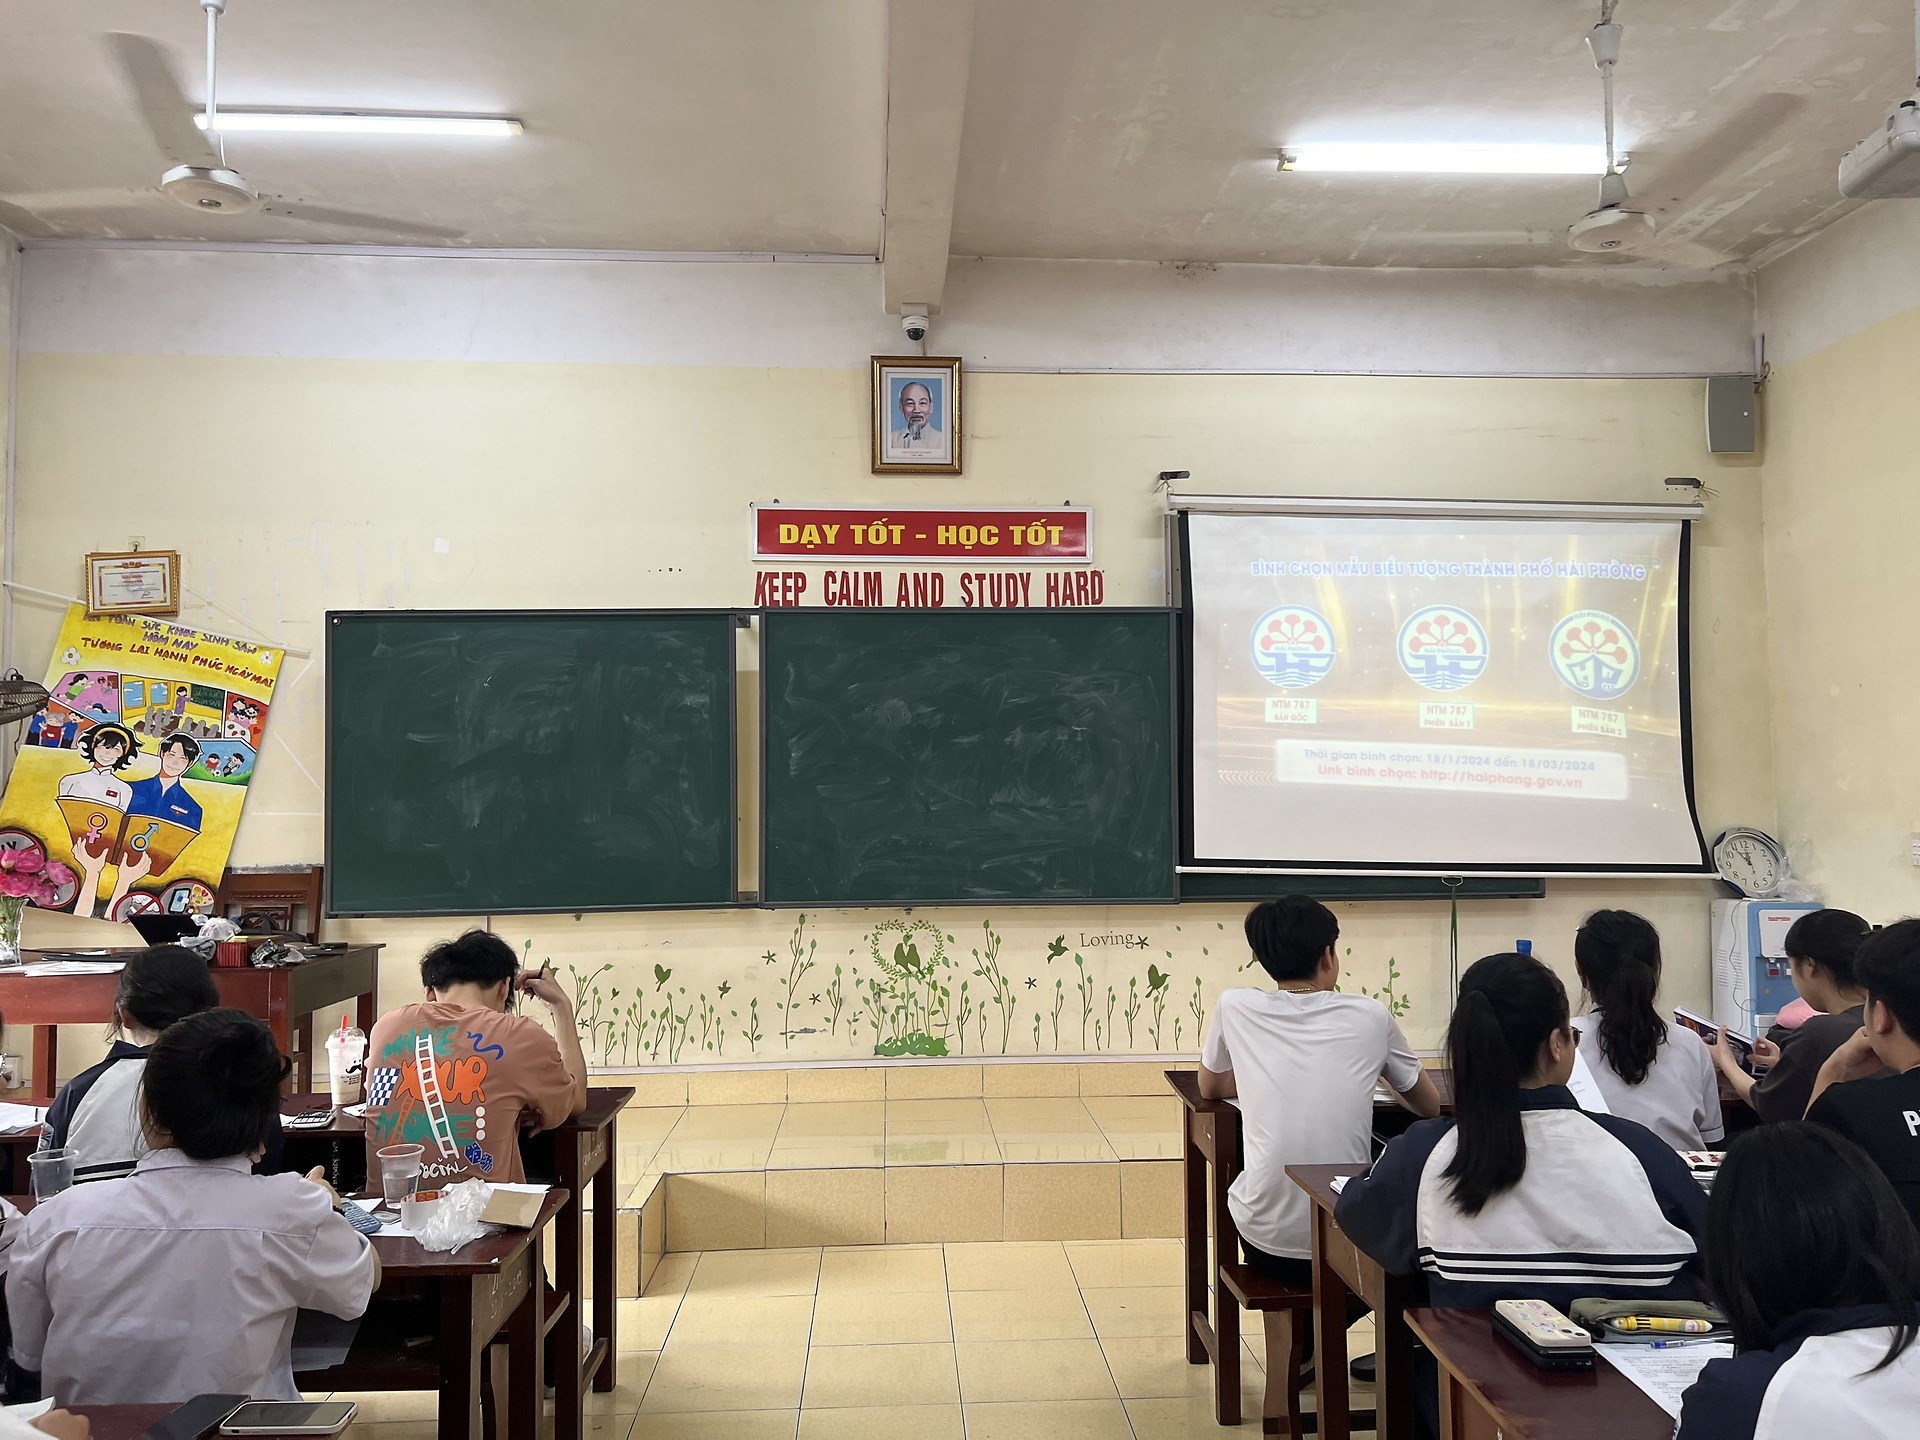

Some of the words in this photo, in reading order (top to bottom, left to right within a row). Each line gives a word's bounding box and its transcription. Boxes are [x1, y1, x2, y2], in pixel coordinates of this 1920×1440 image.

[779, 524, 840, 549] DẠY
[850, 518, 905, 545] TỐT
[937, 525, 999, 549] HỌC
[1009, 518, 1064, 546] TỐT
[1251, 558, 1287, 577] BÌNH
[1289, 561, 1334, 579] CHỌN
[1373, 555, 1405, 577] BIỂU
[1408, 560, 1461, 580] TƯỢNG
[1464, 559, 1516, 577] THÀNH
[1519, 557, 1553, 577] PHỐ
[1588, 559, 1646, 581] PHÒNG
[753, 571, 807, 608] KEEP
[823, 570, 883, 607] CALM
[897, 572, 944, 608] AND
[960, 572, 1031, 608] STUDY
[1046, 570, 1104, 608] HARD
[129, 643, 151, 655] LAI
[1318, 763, 1343, 776] Link
[1331, 750, 1357, 762] gian
[1427, 753, 1491, 766] 18/1/2024
[1079, 930, 1135, 950] Loving
[1902, 1110, 1920, 1137] P
